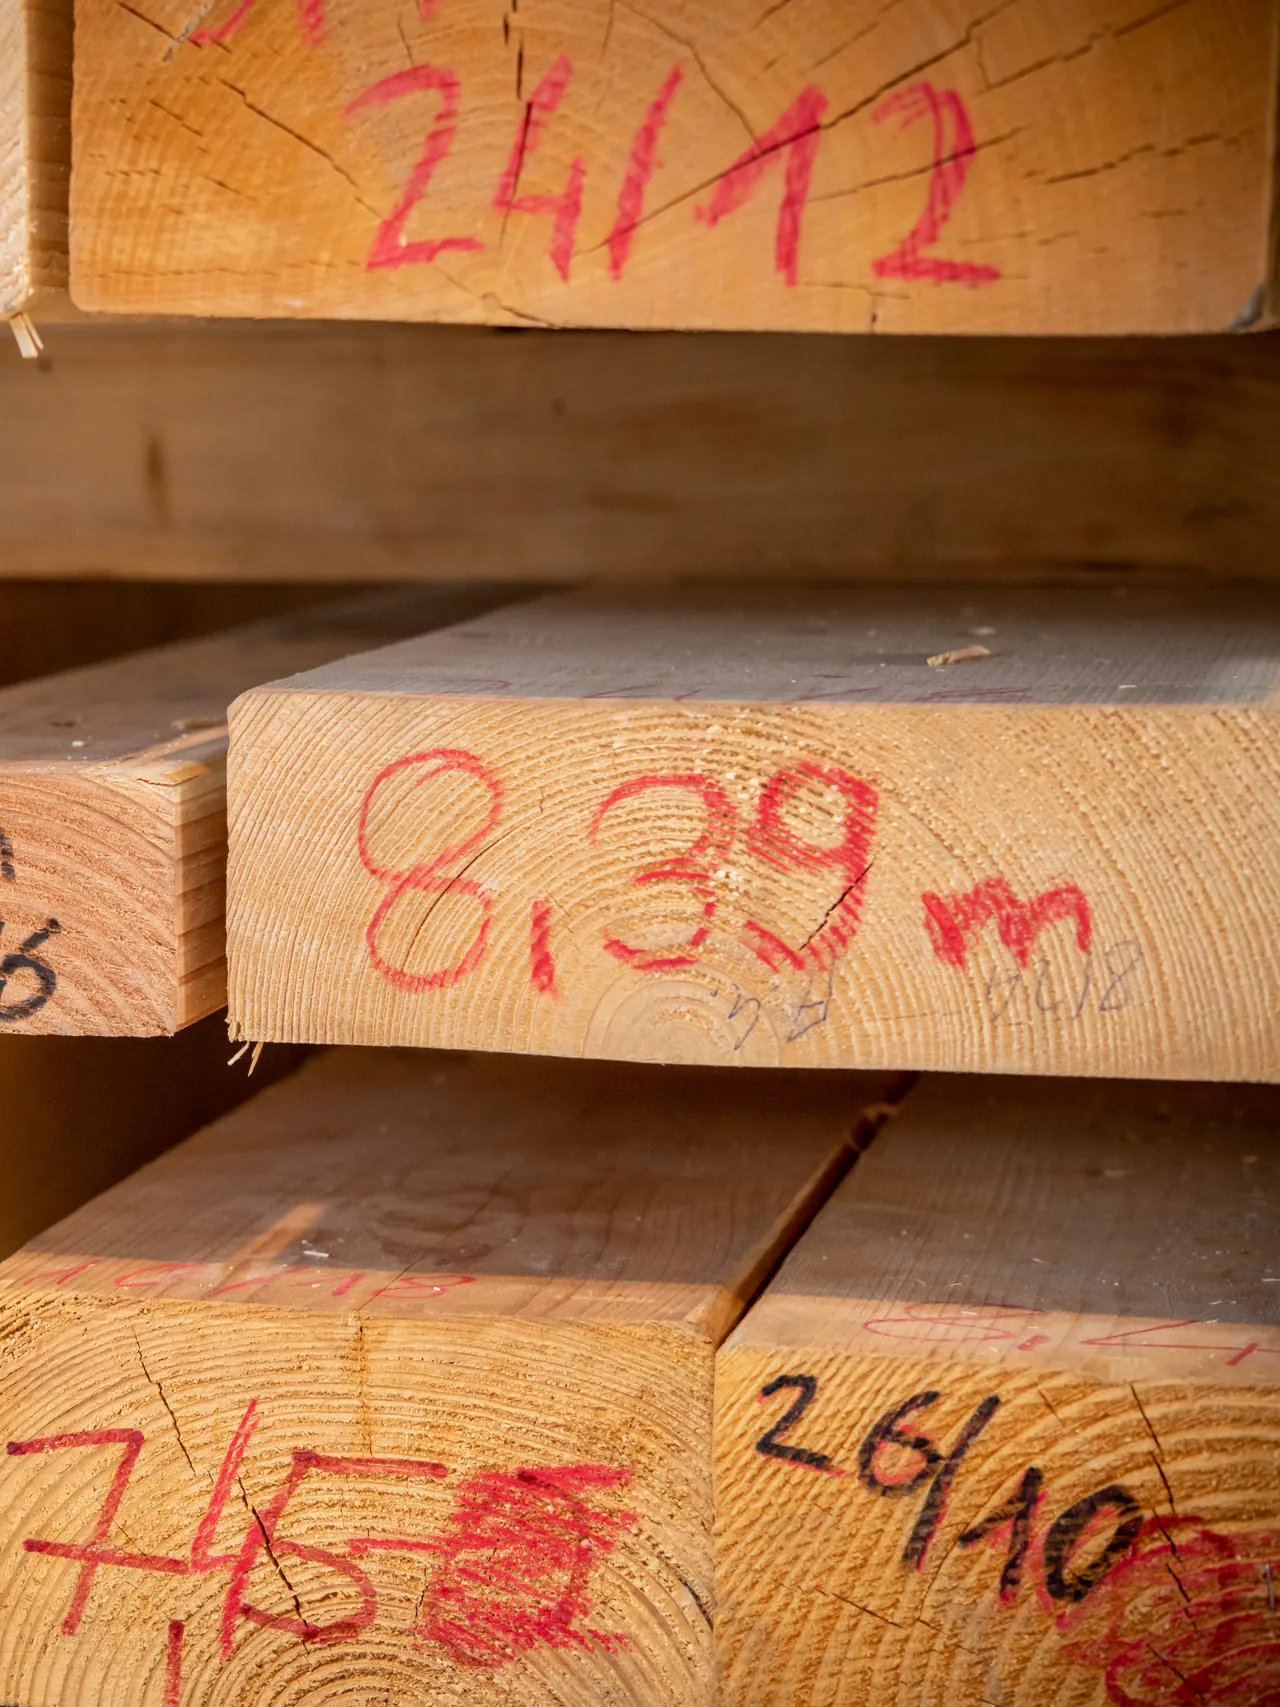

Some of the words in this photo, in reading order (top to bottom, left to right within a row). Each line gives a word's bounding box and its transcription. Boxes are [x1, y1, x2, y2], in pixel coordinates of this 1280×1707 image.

[342, 54, 1002, 287] 24/12
[357, 748, 882, 1002] 8,39
[921, 876, 1093, 970] m
[754, 1373, 1147, 1604] 26/10
